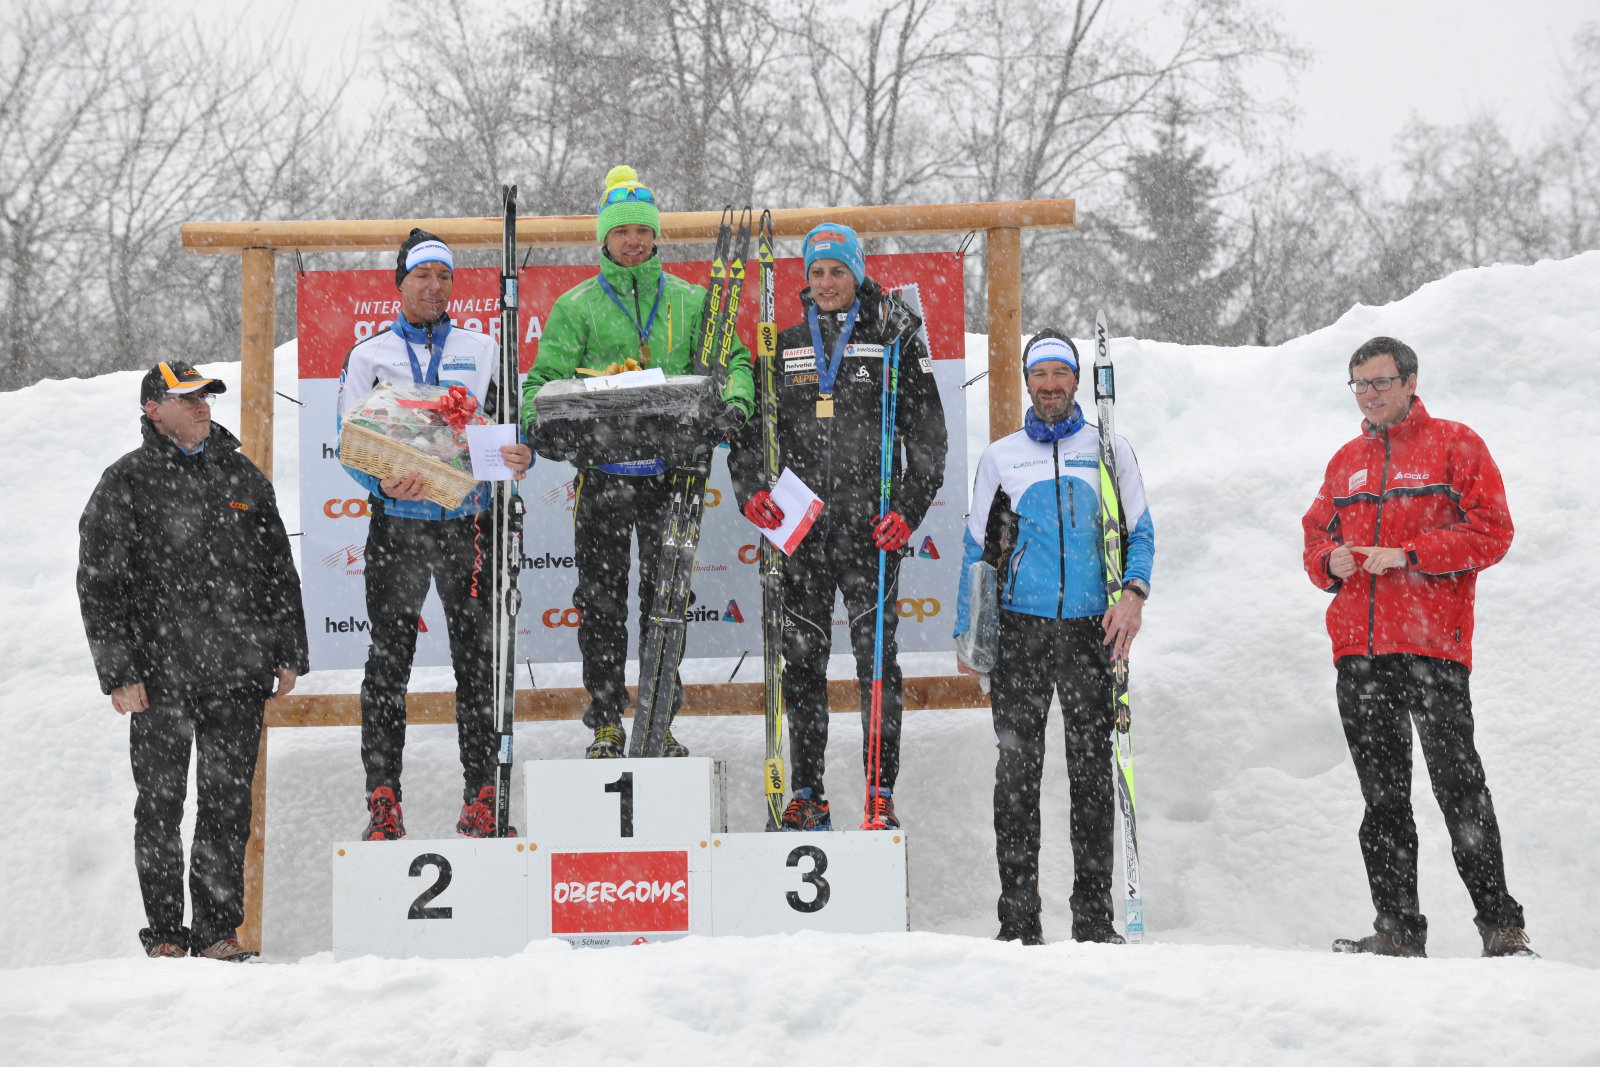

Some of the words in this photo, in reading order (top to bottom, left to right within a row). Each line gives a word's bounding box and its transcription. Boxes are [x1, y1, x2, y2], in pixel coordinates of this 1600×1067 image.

[701, 283, 722, 367] FISCHER
[719, 284, 741, 368] FISCHER
[761, 326, 774, 352] TOKO
[784, 348, 814, 357] RAIFFEIS
[792, 374, 819, 384] ALPIQ
[1020, 459, 1048, 468] KOLPING
[229, 502, 249, 511] coop
[542, 608, 583, 628] co
[686, 604, 719, 623] etia
[896, 597, 941, 623] op
[325, 616, 369, 633] helv
[769, 763, 781, 790] TOKO
[604, 771, 634, 838] 1
[407, 852, 453, 920] 2
[553, 879, 687, 904] OBERGOMS
[785, 845, 831, 913] 3
